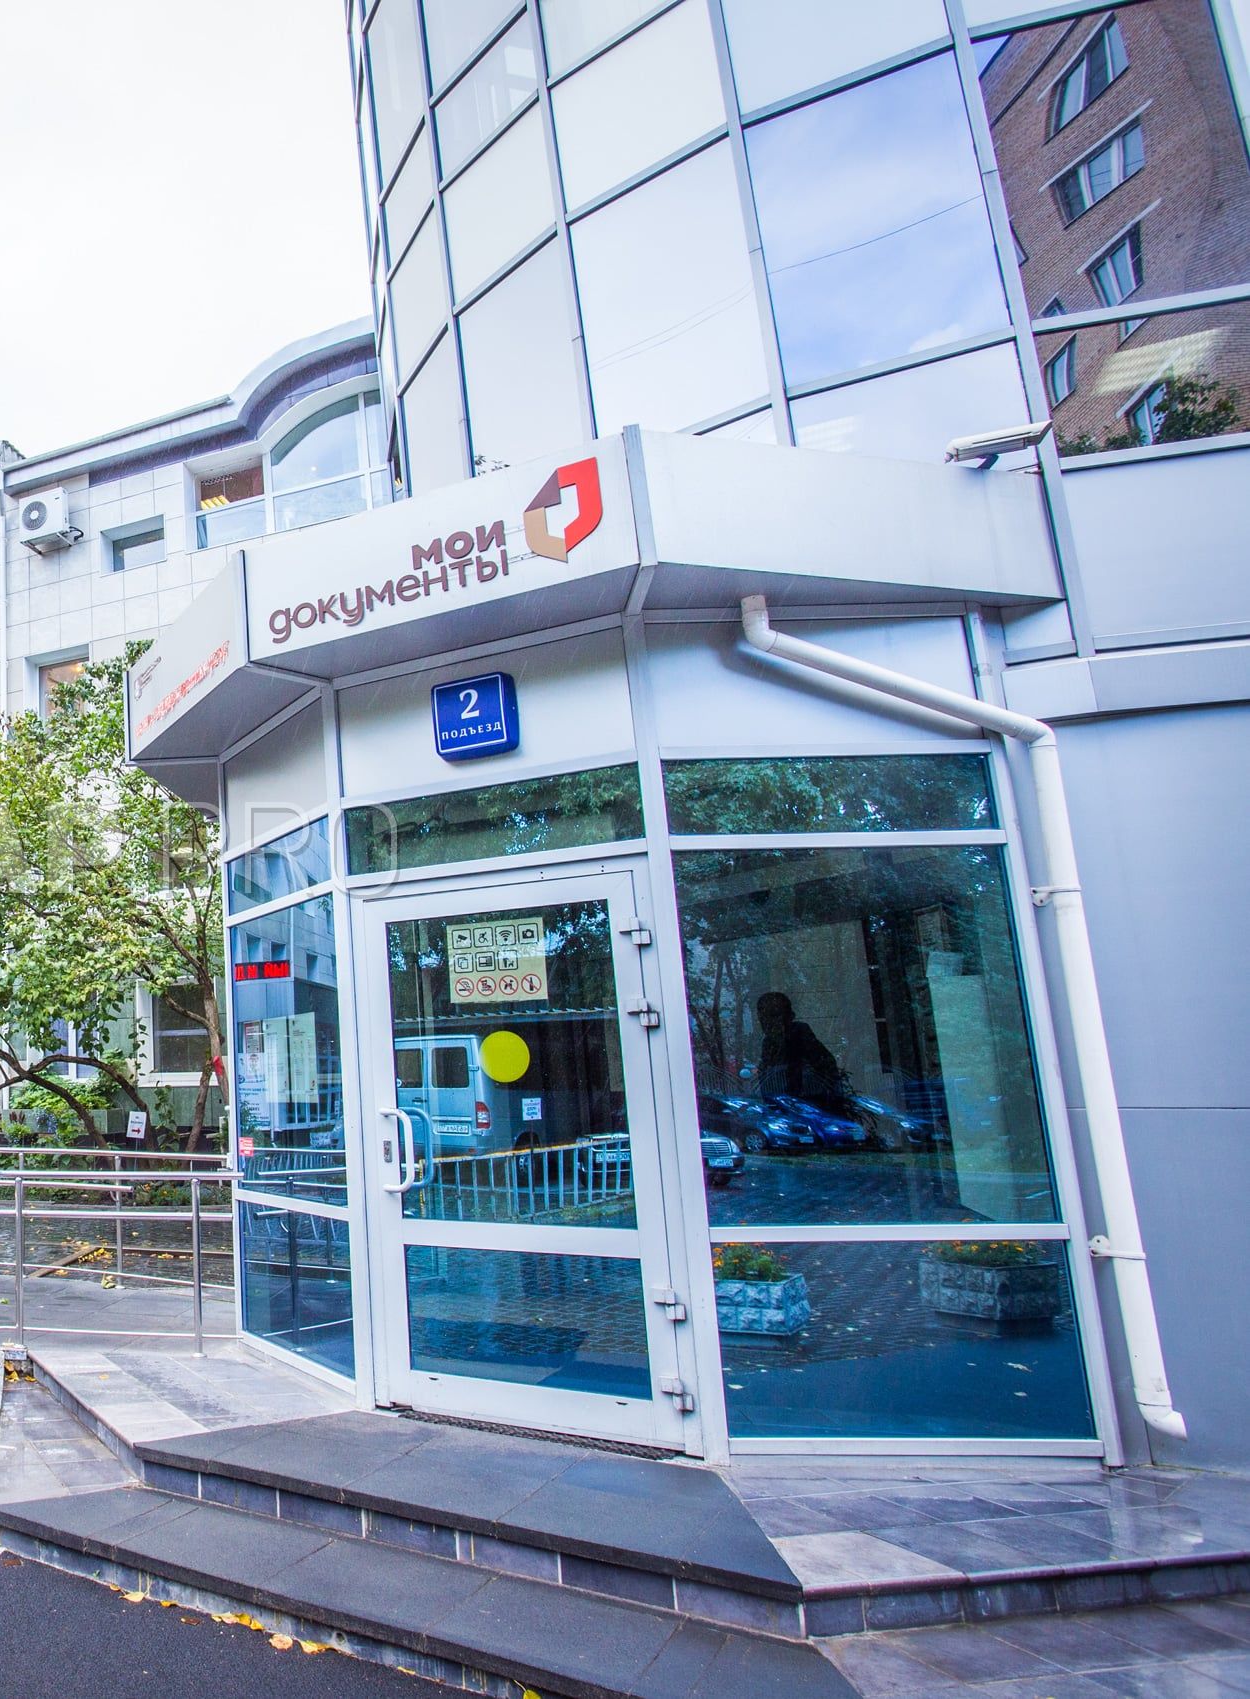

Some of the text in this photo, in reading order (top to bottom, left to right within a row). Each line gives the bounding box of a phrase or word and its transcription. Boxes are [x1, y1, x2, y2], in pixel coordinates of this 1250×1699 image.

[268, 549, 509, 644] документы
[459, 689, 480, 720] 2
[441, 721, 502, 741] ПОДЪЕЗД
